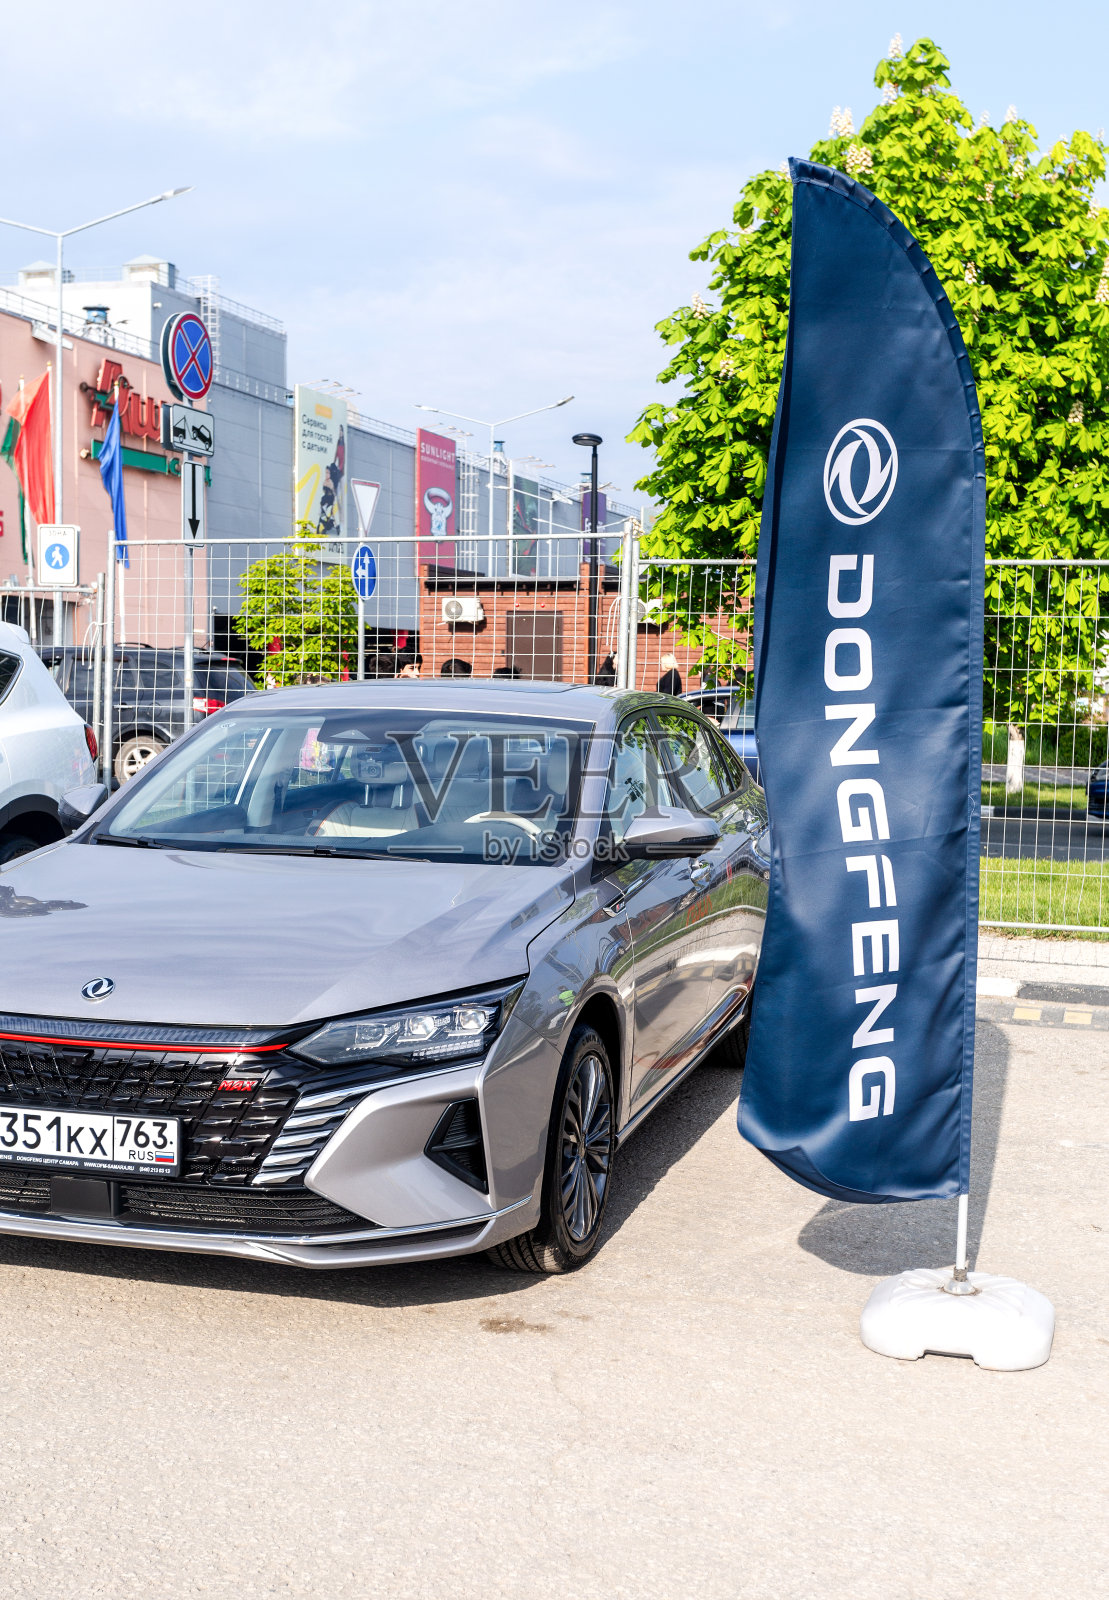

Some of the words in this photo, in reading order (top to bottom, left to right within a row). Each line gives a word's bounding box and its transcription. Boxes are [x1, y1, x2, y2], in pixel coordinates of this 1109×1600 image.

[302, 414, 327, 430] Сервисы
[302, 429, 313, 438] для
[314, 432, 333, 443] гостей
[307, 442, 328, 453] детьми
[420, 442, 455, 464] SUNLIGHT
[824, 553, 899, 1123] DONGFENG
[217, 1079, 257, 1092] MAX
[16, 1155, 42, 1163] DONGFENG
[128, 1150, 154, 1161] RUS
